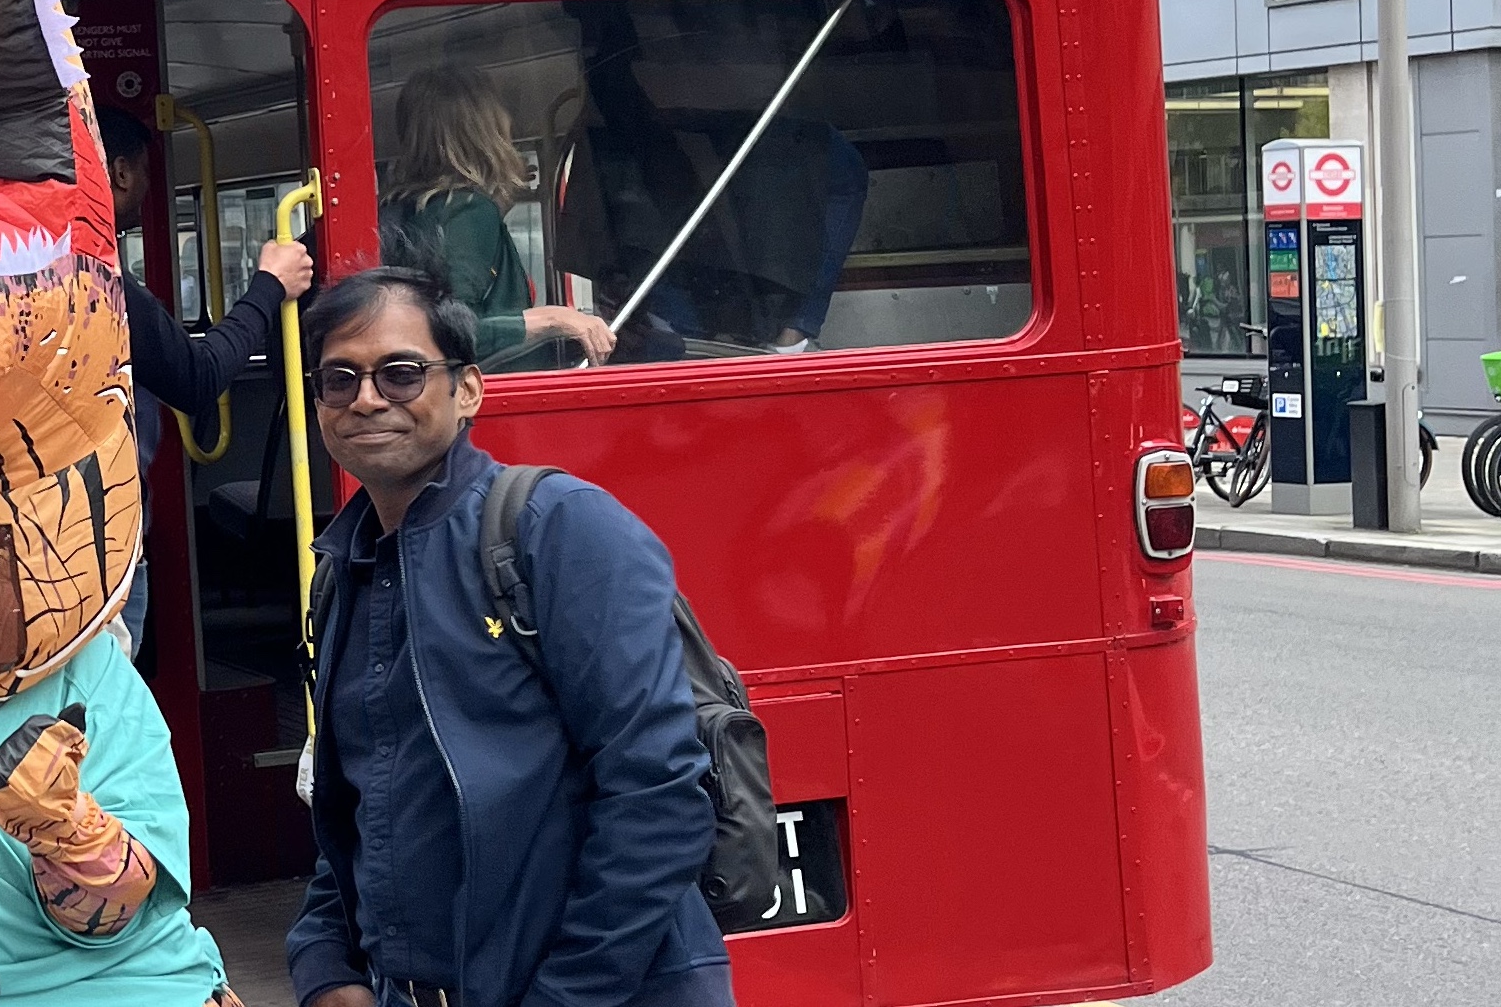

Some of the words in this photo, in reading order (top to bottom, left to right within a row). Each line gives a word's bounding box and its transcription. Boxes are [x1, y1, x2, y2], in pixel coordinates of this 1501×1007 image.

[116, 23, 142, 34] MUST
[100, 37, 124, 47] GIVE
[117, 48, 152, 57] SIGNAL
